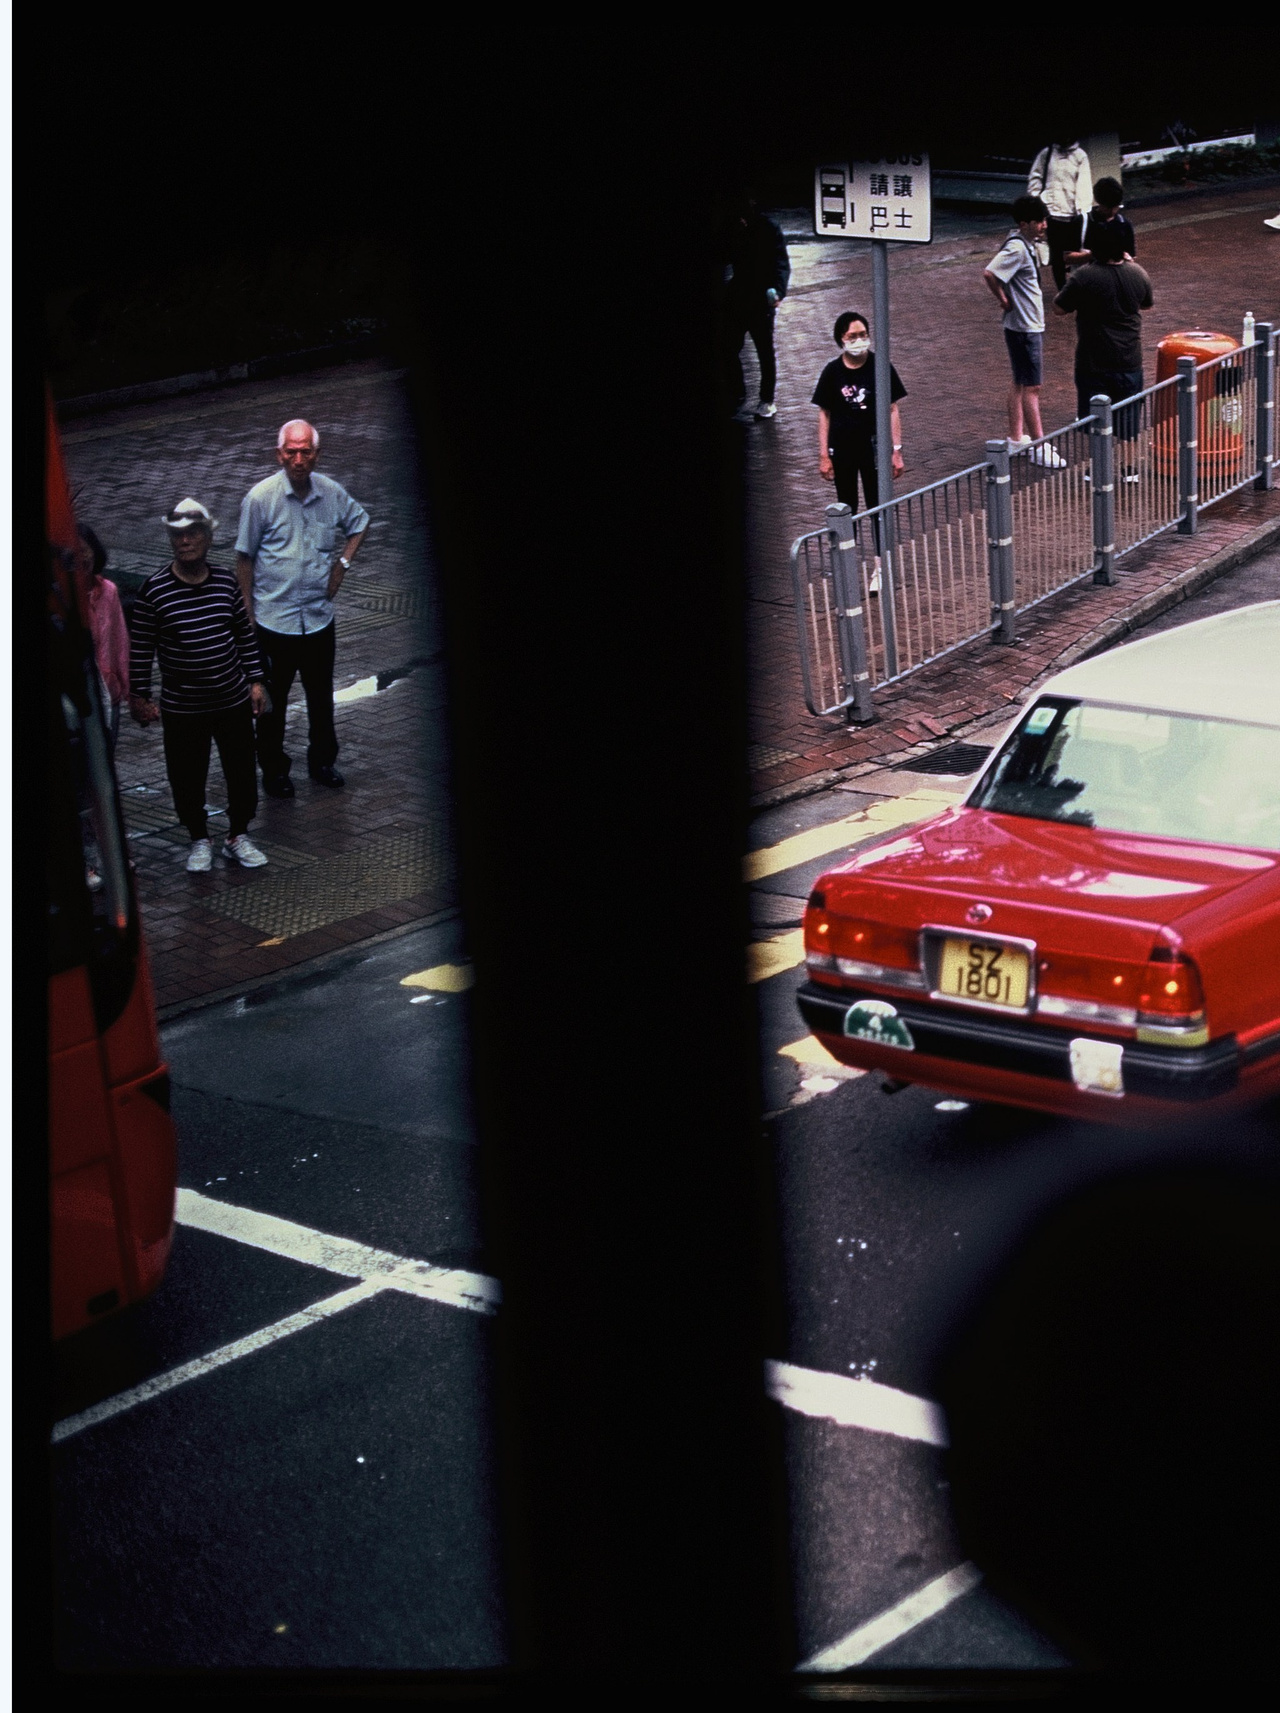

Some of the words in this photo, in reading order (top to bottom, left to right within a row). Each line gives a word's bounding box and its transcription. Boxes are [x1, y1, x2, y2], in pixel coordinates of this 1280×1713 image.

[869, 173, 913, 197] 請讓
[870, 206, 913, 229] 巴士
[968, 943, 1004, 973] SZ
[957, 966, 1011, 1001] 1801
[867, 1015, 883, 1033] 4
